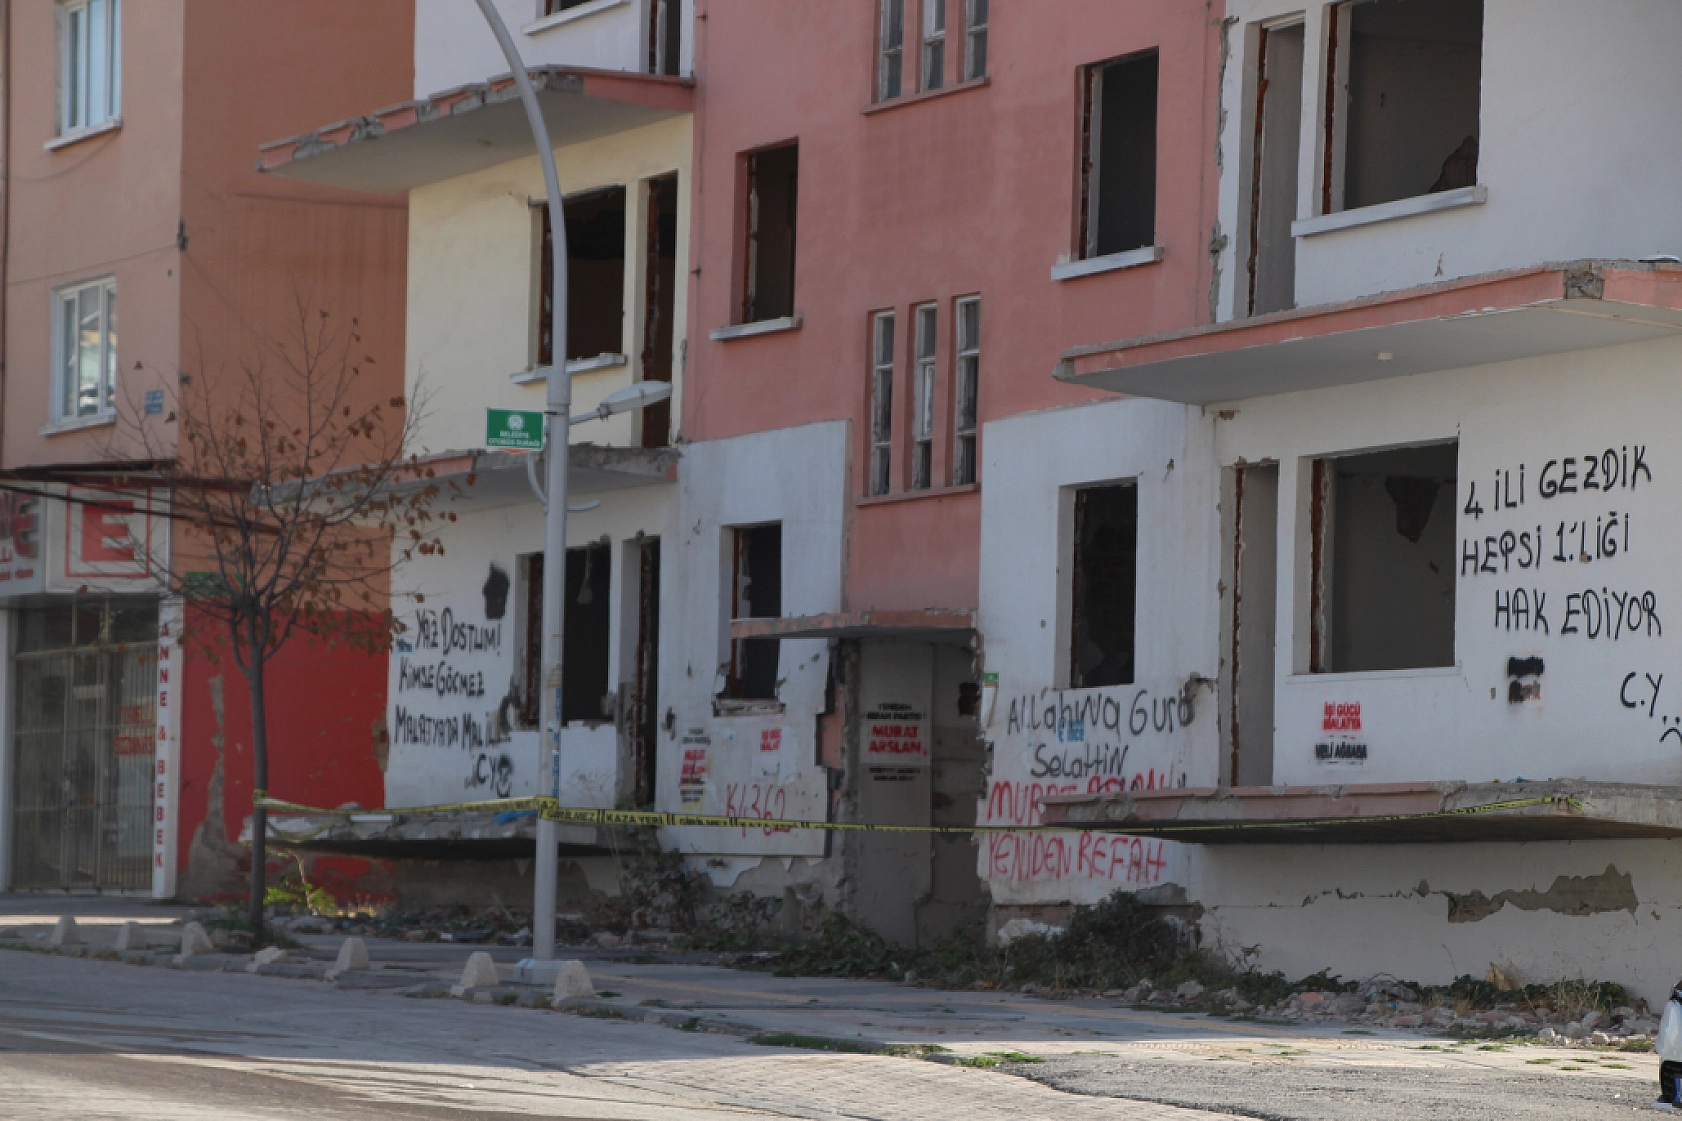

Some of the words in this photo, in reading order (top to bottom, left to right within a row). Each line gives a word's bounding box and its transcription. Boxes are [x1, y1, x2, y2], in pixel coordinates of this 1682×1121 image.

[1463, 480, 1485, 520] 4
[1494, 463, 1525, 512] İLİ
[1539, 445, 1653, 499] GEZDİK
[82, 499, 134, 562] E
[1461, 524, 1541, 577] HEPSİ
[1495, 586, 1550, 636] HAK
[1560, 586, 1662, 641] EDİYOR
[159, 622, 170, 707] ANNE
[872, 724, 919, 738] MURAT
[154, 758, 167, 870] BEBEK
[1077, 830, 1168, 882] REFAH
